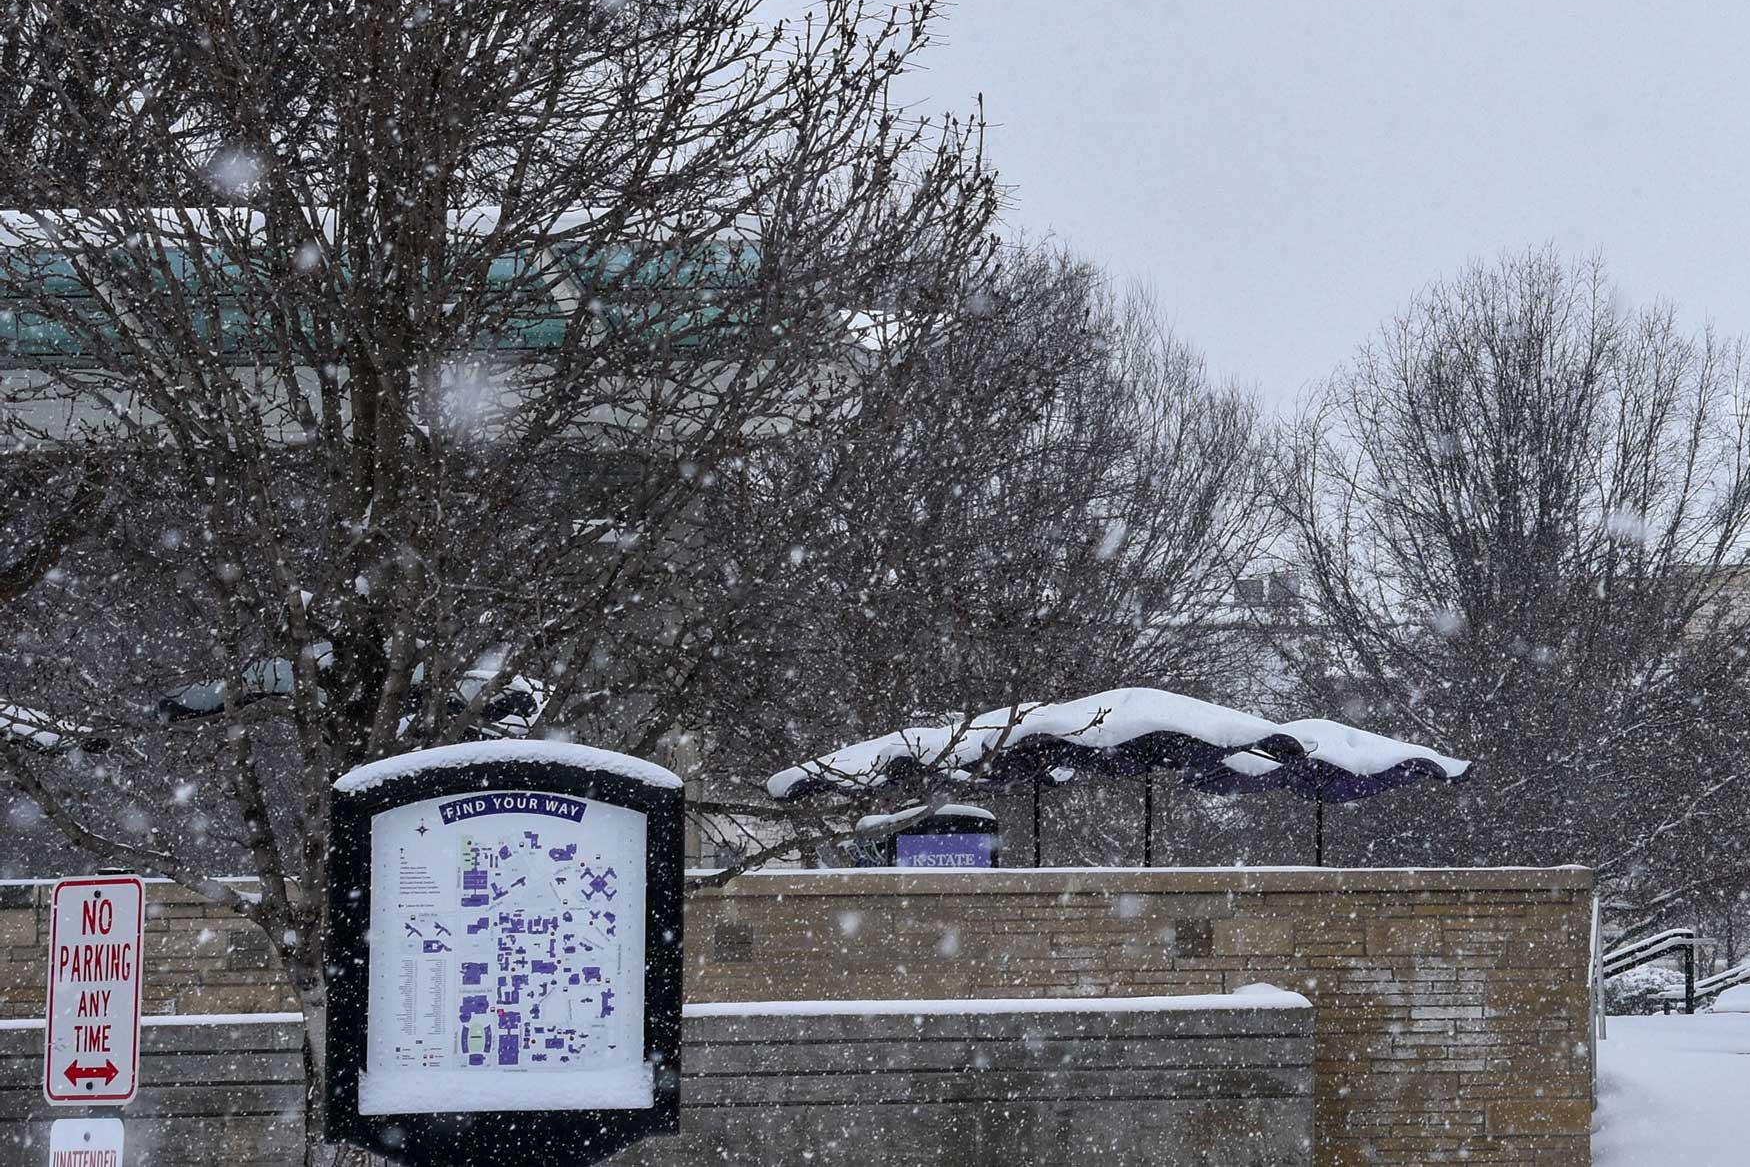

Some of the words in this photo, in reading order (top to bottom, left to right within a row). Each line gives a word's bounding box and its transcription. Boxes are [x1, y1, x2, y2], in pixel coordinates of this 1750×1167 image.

[445, 800, 486, 819] FIND
[493, 797, 538, 810] YOUR
[545, 800, 580, 817] WAY
[912, 853, 976, 867] K-STATE
[81, 898, 113, 935] NO
[59, 942, 131, 983] PARKING
[77, 989, 112, 1018] ANY
[73, 1024, 112, 1053] TIME
[52, 1149, 117, 1167] UNATTENDED
